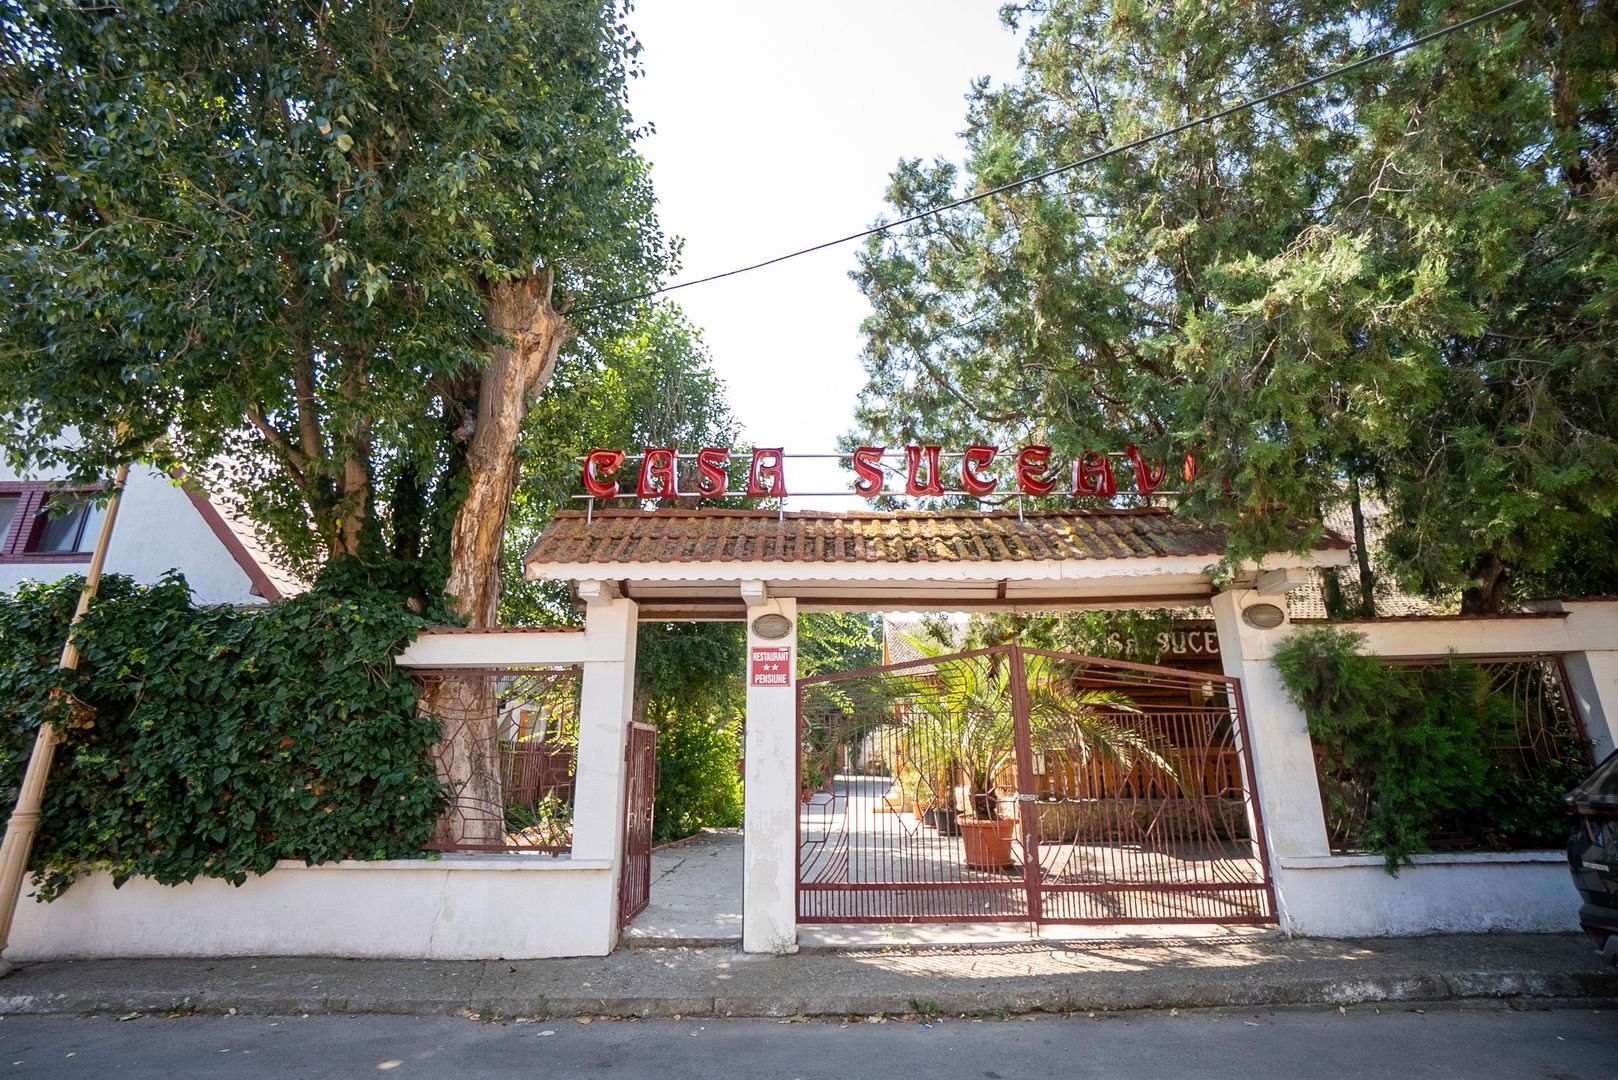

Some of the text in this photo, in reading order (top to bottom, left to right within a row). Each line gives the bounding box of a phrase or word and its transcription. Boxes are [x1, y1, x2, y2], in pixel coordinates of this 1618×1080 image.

[583, 443, 1233, 499] CASA SUCEAV
[753, 652, 789, 661] RESTAURANT
[755, 674, 787, 684] PENSIUNE
